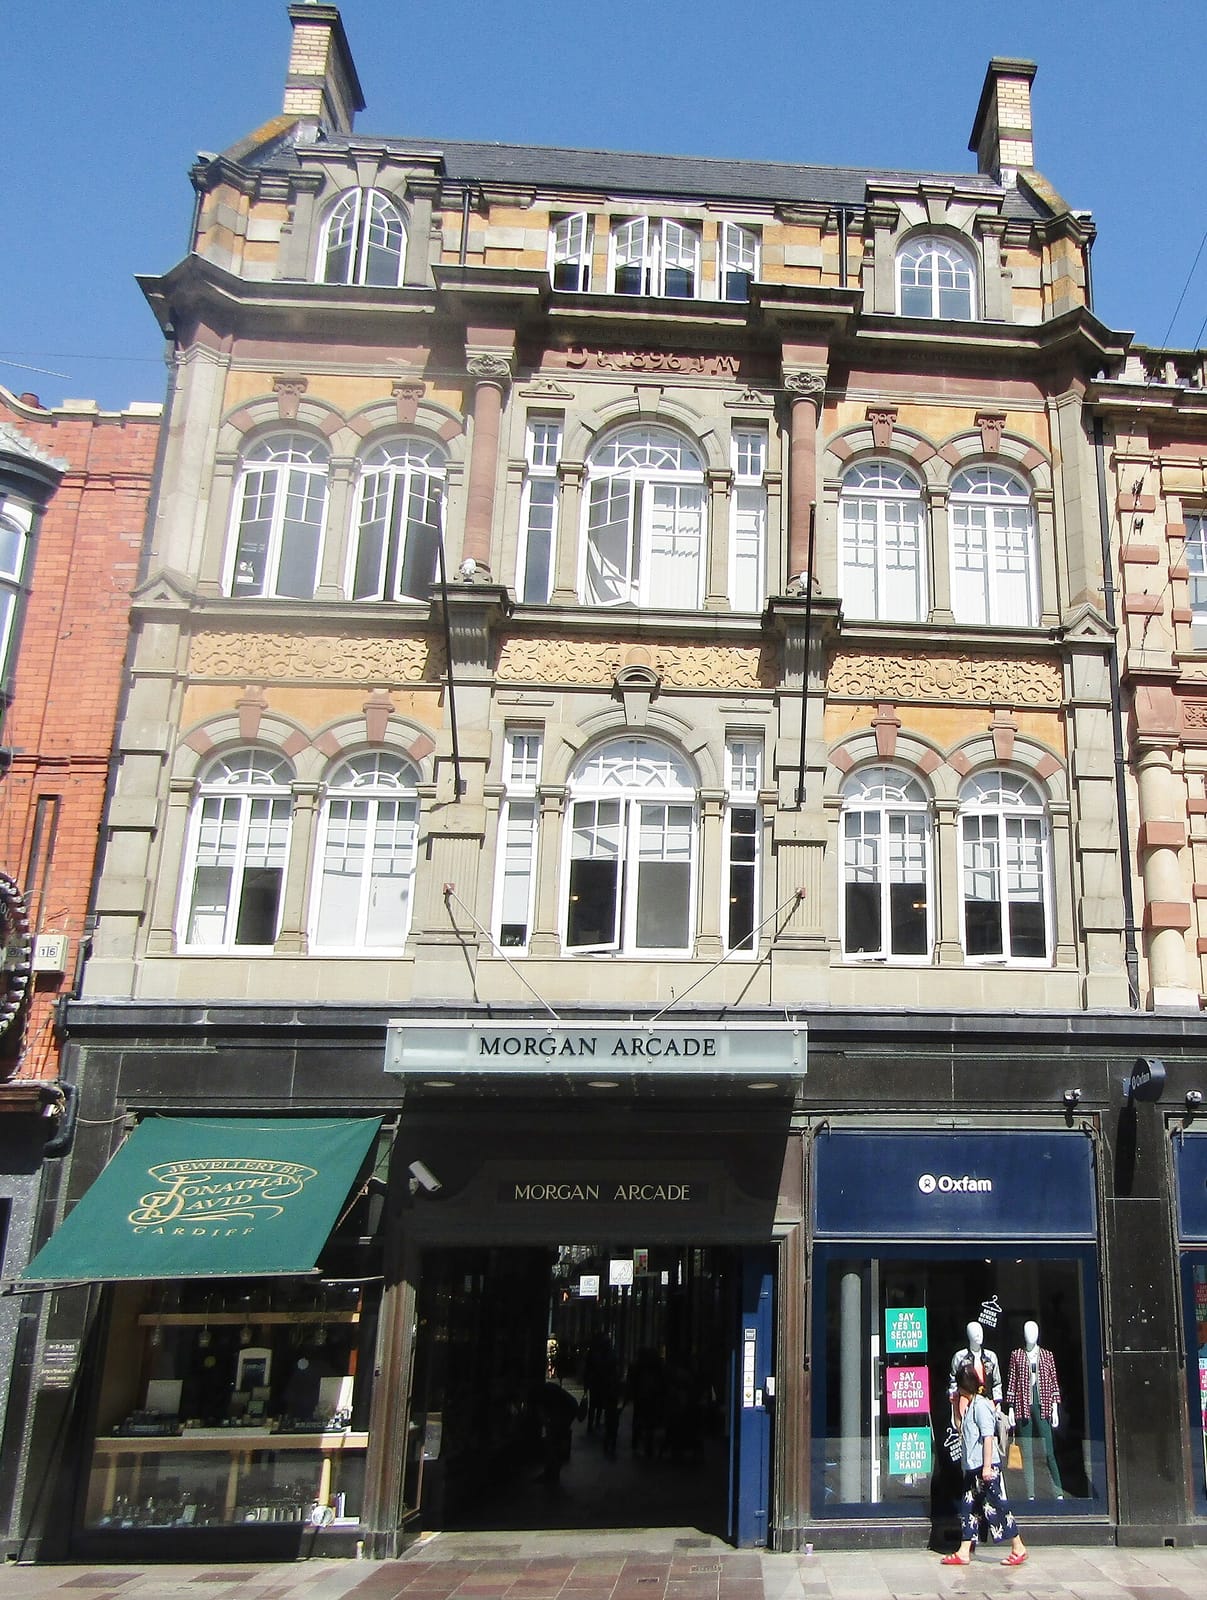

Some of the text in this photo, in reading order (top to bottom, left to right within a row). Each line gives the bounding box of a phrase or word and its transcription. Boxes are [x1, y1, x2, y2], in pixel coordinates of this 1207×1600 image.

[40, 947, 56, 957] 16
[480, 1037, 716, 1057] MORGAN ARCADE
[168, 1160, 305, 1176] JEWELLERY BY
[938, 1175, 992, 1192] Oxfam
[140, 1174, 304, 1207] JONATHAN
[514, 1184, 691, 1200] MORGAN ARCADE
[128, 1192, 254, 1225] DAVID
[132, 1226, 255, 1237] CARDIFF
[898, 1312, 914, 1321] SAY
[892, 1321, 921, 1330] YES TO
[890, 1330, 923, 1339] SECOND
[895, 1339, 918, 1349] HAND
[899, 1372, 915, 1381] SAY
[892, 1380, 922, 1390] YES TO
[891, 1390, 924, 1399] SECOND
[896, 1399, 920, 1409] HAND
[902, 1432, 918, 1441] SAY
[896, 1441, 925, 1450] YES TO
[894, 1451, 927, 1460] SECOND
[899, 1460, 922, 1469] HAND
